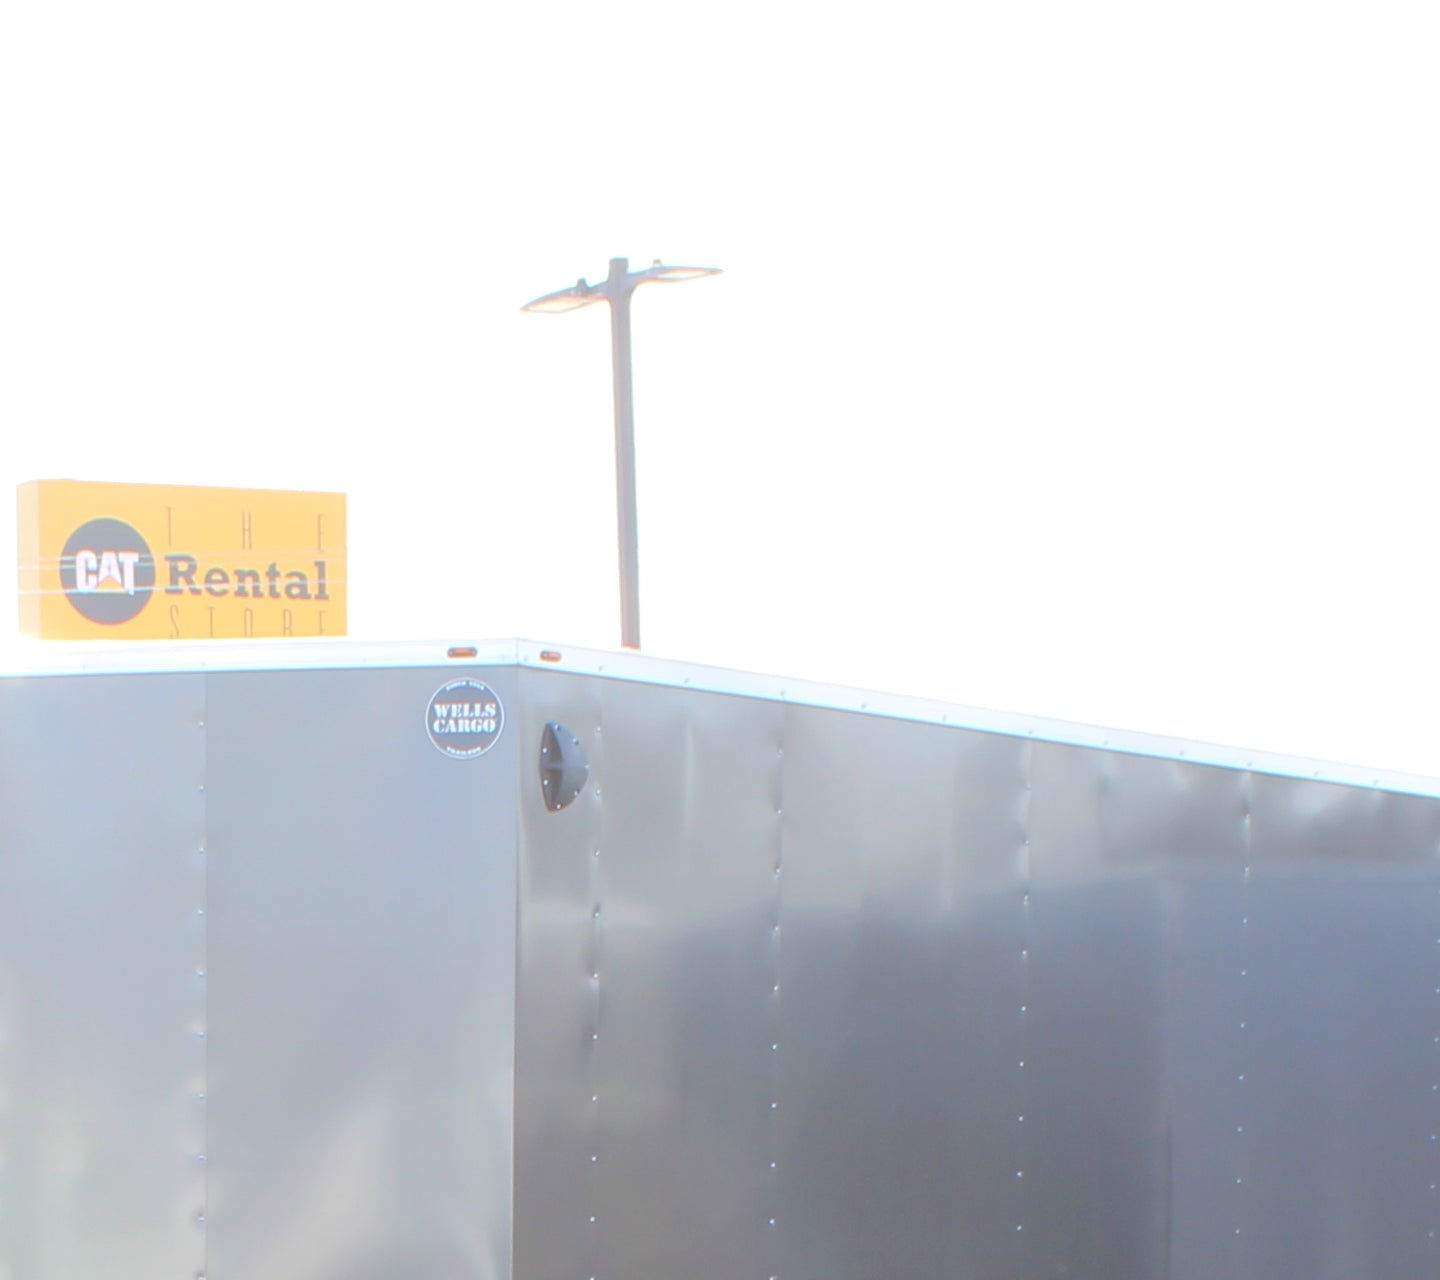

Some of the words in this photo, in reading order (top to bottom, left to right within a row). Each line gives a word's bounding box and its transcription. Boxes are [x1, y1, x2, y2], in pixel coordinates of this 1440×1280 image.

[164, 506, 325, 554] THE
[75, 548, 140, 595] CAT
[164, 553, 330, 601] Rental
[432, 718, 497, 734] CARGO
[433, 702, 497, 718] WELLS
